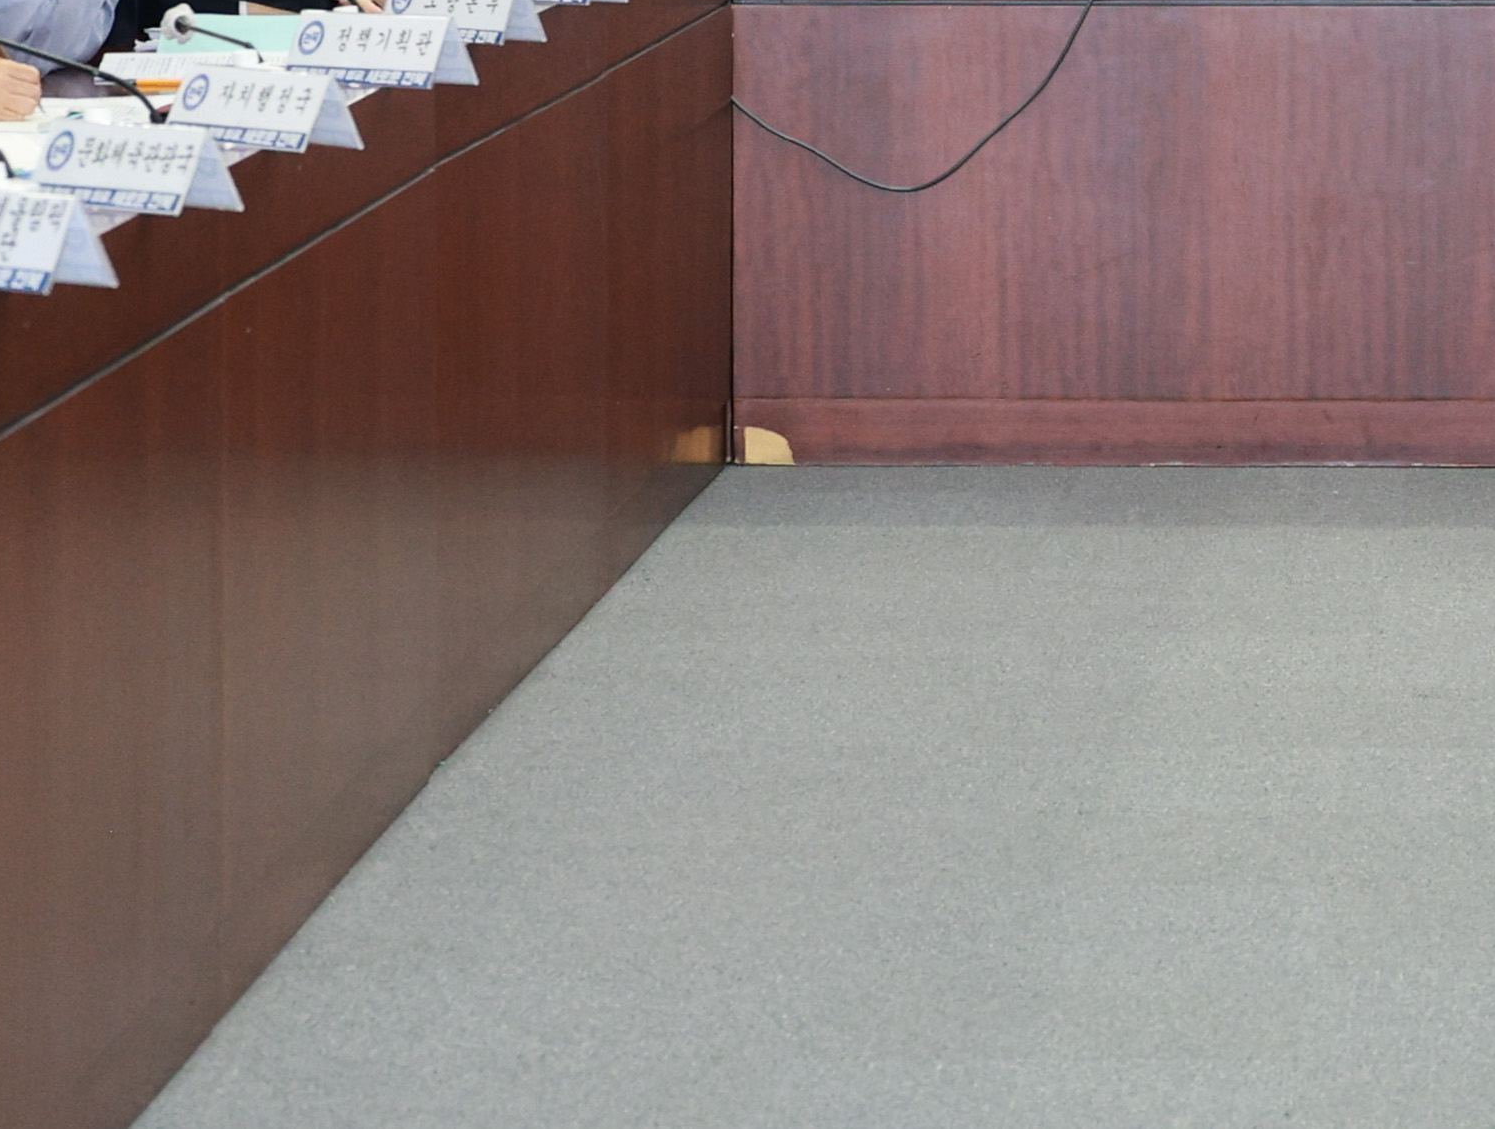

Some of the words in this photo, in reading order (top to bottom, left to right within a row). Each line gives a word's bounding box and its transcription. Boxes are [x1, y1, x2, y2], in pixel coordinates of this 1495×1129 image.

[336, 26, 433, 56] 정책기획관
[219, 79, 313, 115] 자치행정국
[77, 136, 195, 175] 문화체육관광국
